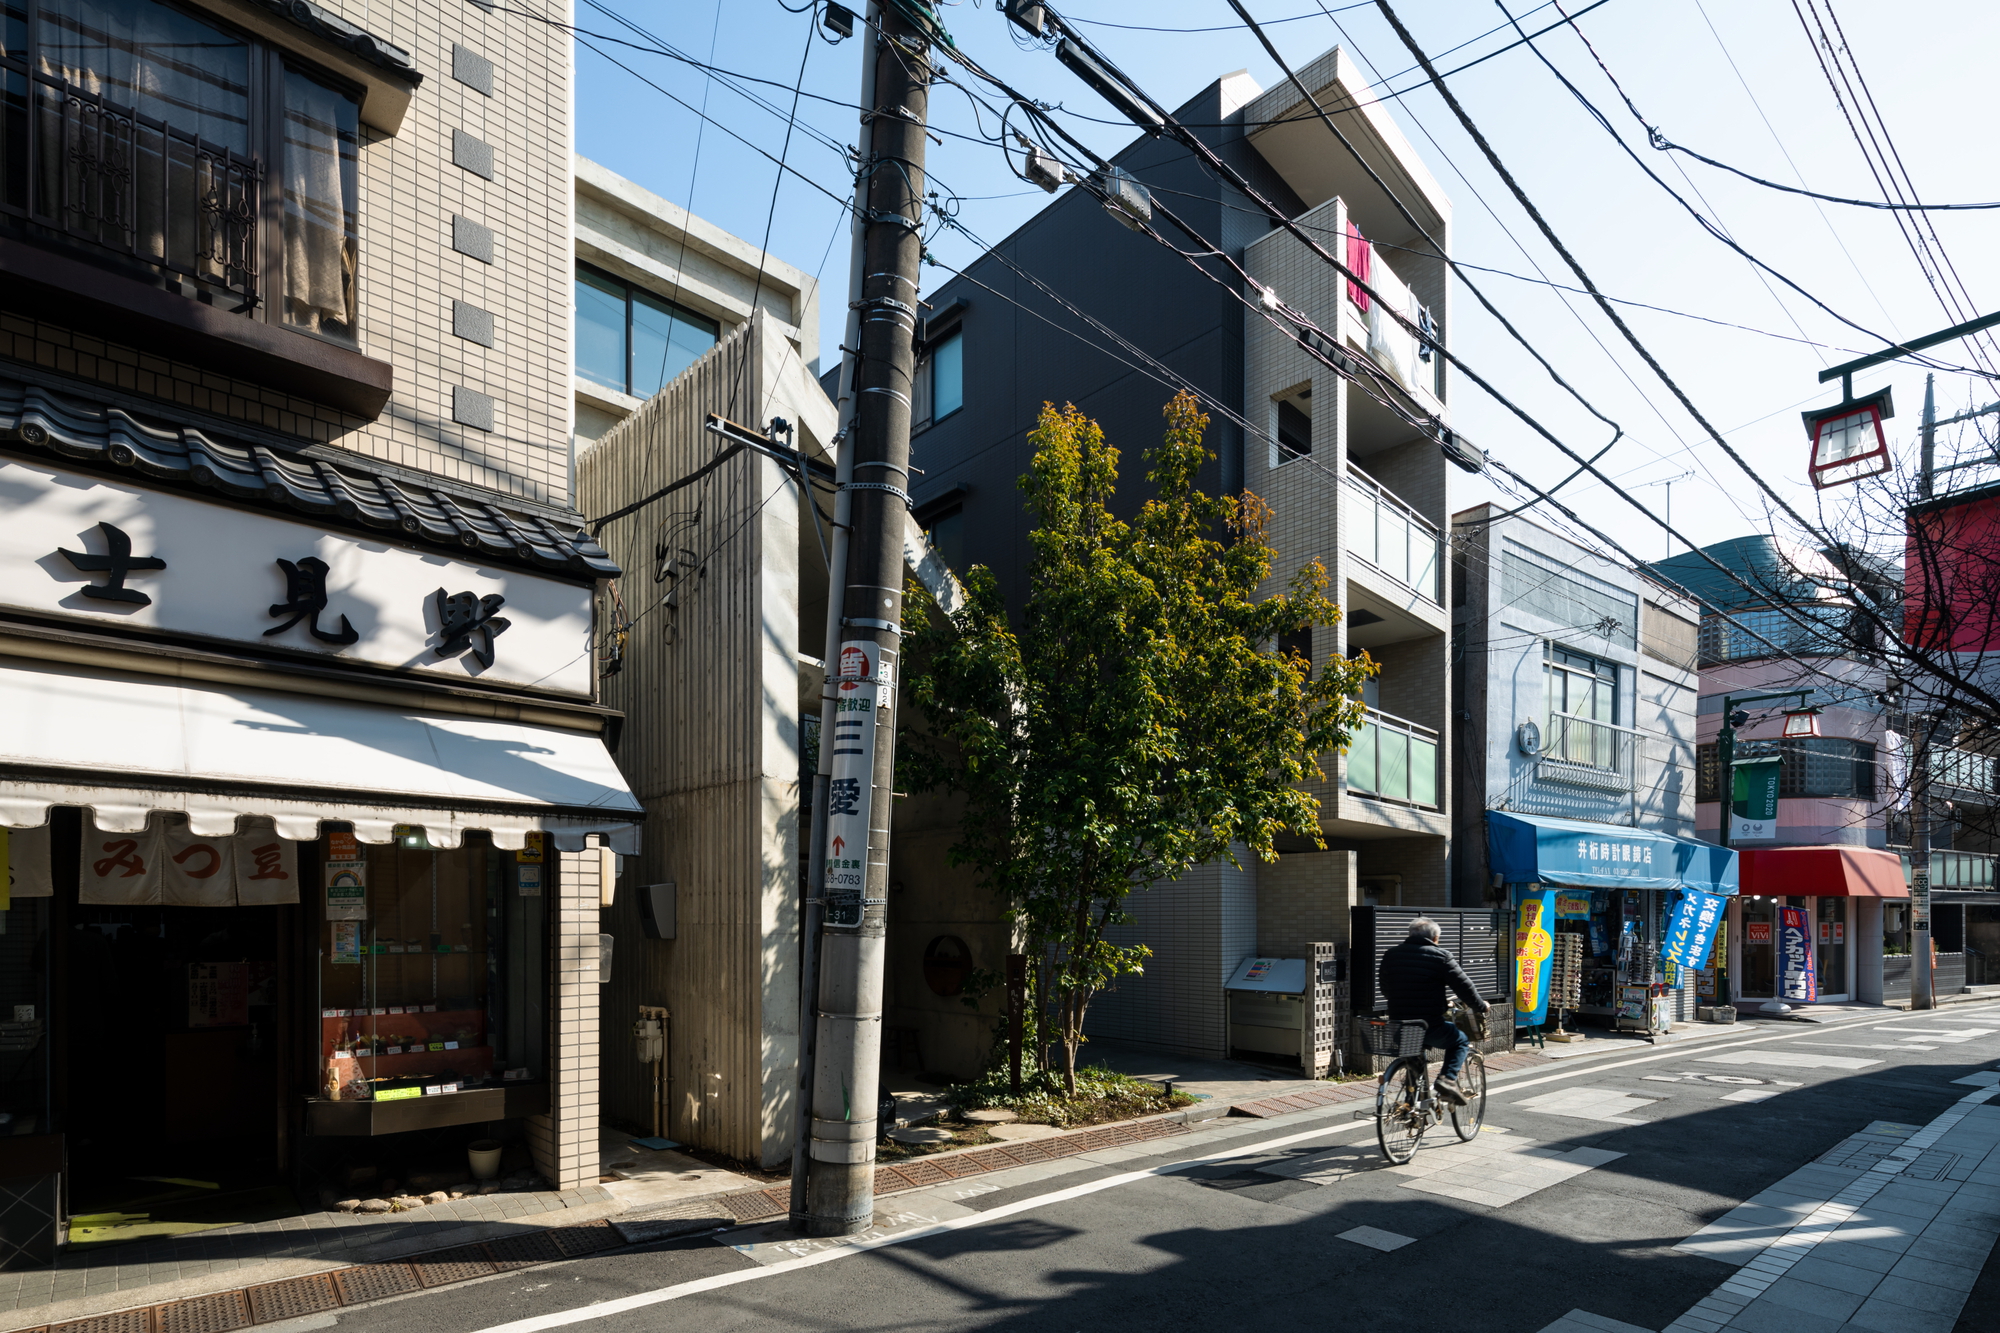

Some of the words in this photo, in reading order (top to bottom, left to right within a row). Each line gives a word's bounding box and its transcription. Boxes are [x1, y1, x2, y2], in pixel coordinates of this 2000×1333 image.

[57, 520, 512, 671] 士見野
[835, 697, 871, 712] 客歓迎
[829, 720, 864, 816] 三愛
[1766, 776, 1776, 799] TOKYO
[1765, 799, 1774, 816] 2020
[92, 838, 290, 881] みつ豆
[1577, 840, 1652, 864] 井桁時計眼鏡店
[1524, 903, 1537, 928] 時計の
[1666, 892, 1698, 964] メガネレンズ
[1531, 932, 1545, 957] バンド
[1685, 897, 1720, 968] 交換できます
[1751, 931, 1769, 939] ViVi
[1783, 927, 1807, 1000] ヘアカット専門店
